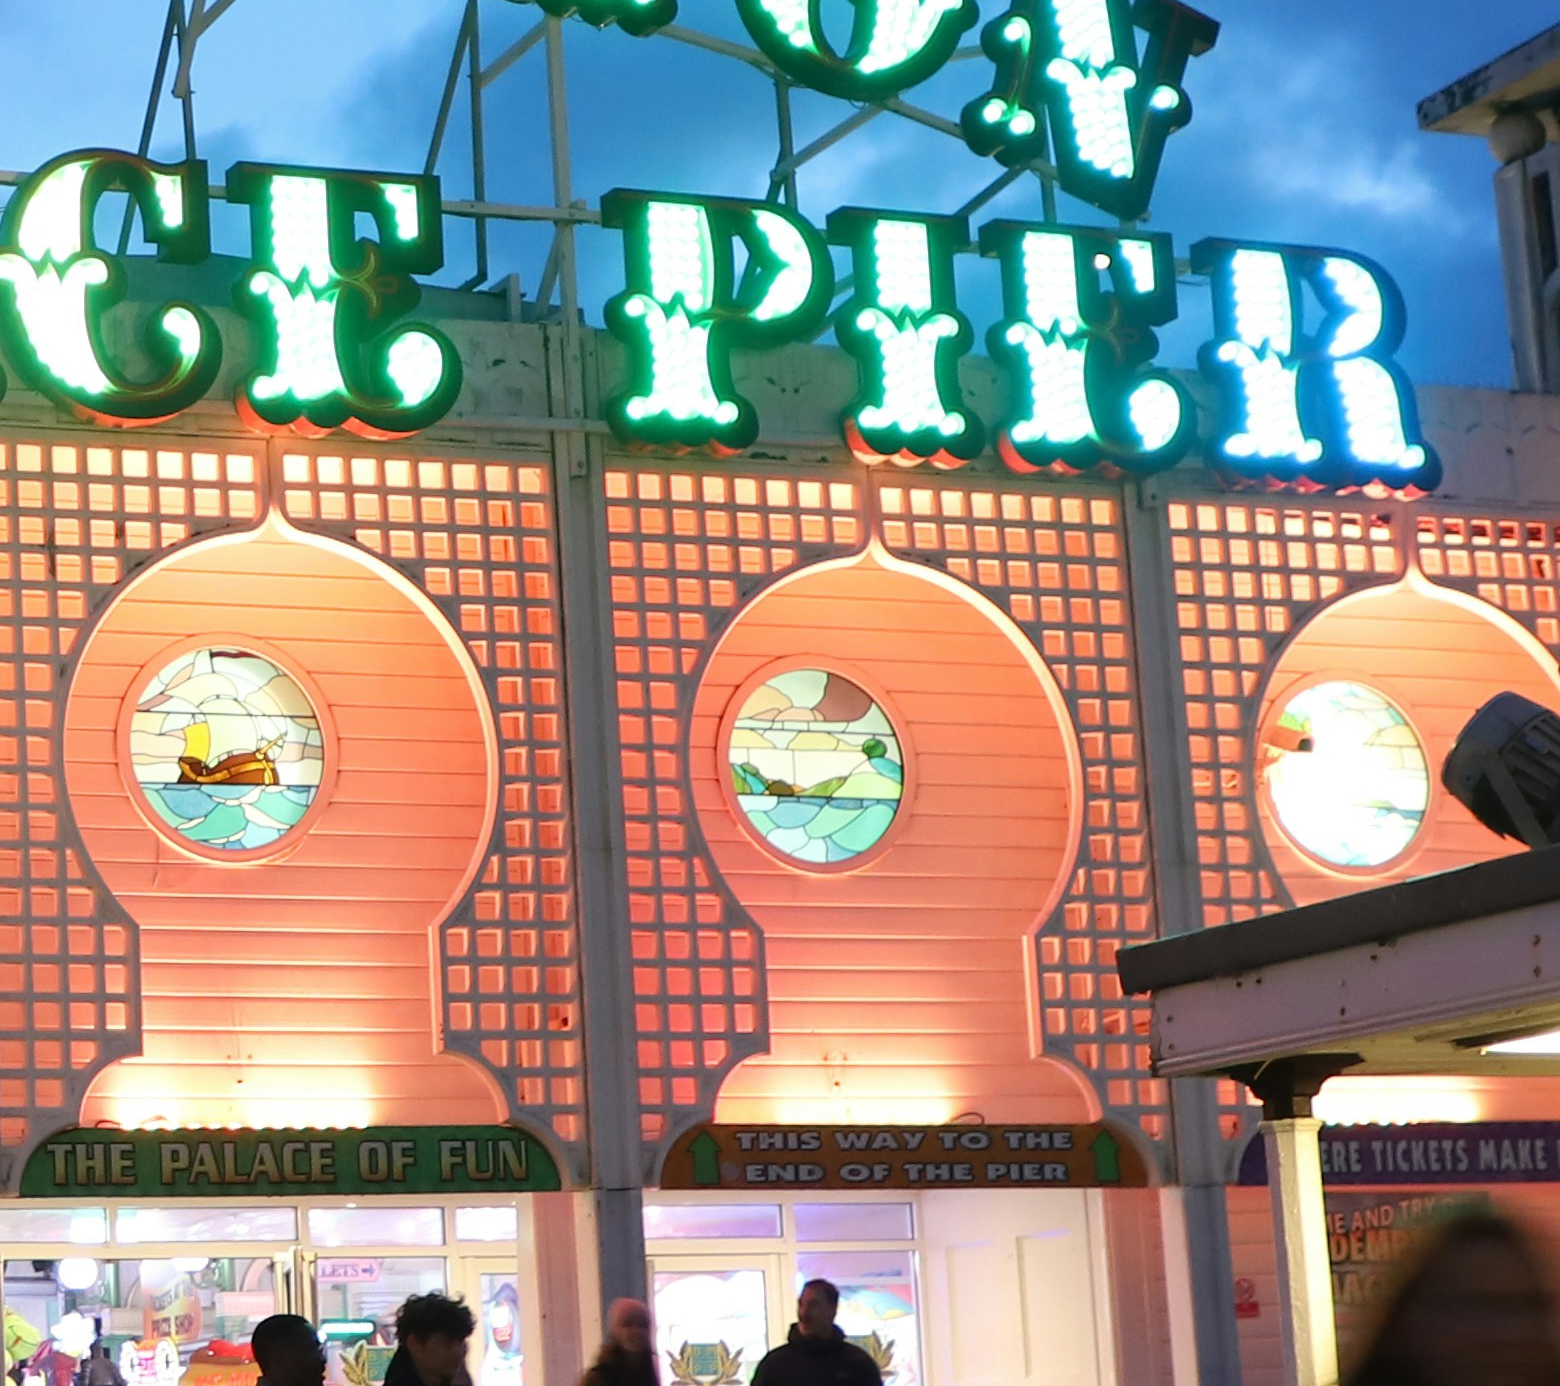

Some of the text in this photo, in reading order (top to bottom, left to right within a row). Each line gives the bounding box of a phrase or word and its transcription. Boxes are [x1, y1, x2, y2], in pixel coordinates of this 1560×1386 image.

[602, 188, 1443, 497] PIER
[733, 1129, 1073, 1152] THIS WAY TO THE
[45, 1138, 529, 1186] THE PALACE OF FUN
[1321, 1140, 1362, 1174] ERE
[1371, 1138, 1470, 1173] TICKETS
[1480, 1138, 1548, 1172] MAKE
[743, 1161, 1067, 1183] END OF THE PIER
[320, 1264, 359, 1277] LETS
